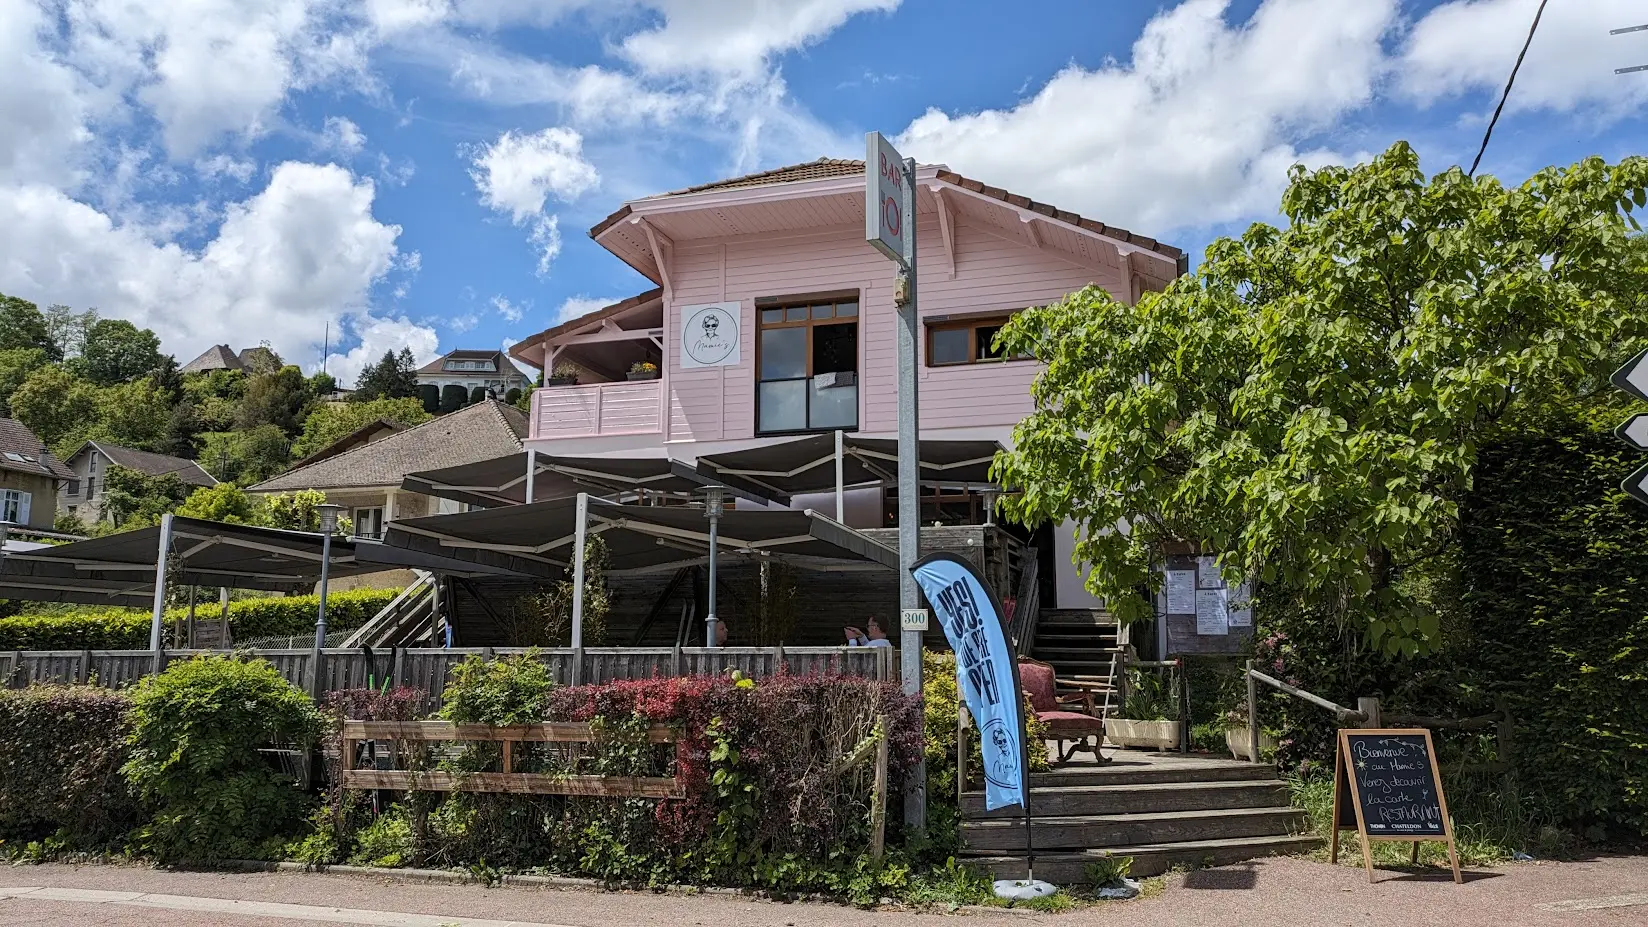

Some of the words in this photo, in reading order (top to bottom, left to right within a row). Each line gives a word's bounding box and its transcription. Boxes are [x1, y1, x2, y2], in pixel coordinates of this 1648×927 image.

[881, 152, 902, 191] BAR
[904, 612, 925, 624] 300
[937, 576, 983, 639] YES!
[960, 635, 979, 669] WE
[968, 658, 1000, 709] OEN
[1354, 741, 1409, 758] Bienvenue
[1360, 772, 1391, 793] Venez
[1366, 793, 1385, 806] la
[1385, 791, 1413, 803] carte
[1378, 803, 1440, 822] RESTAURANT
